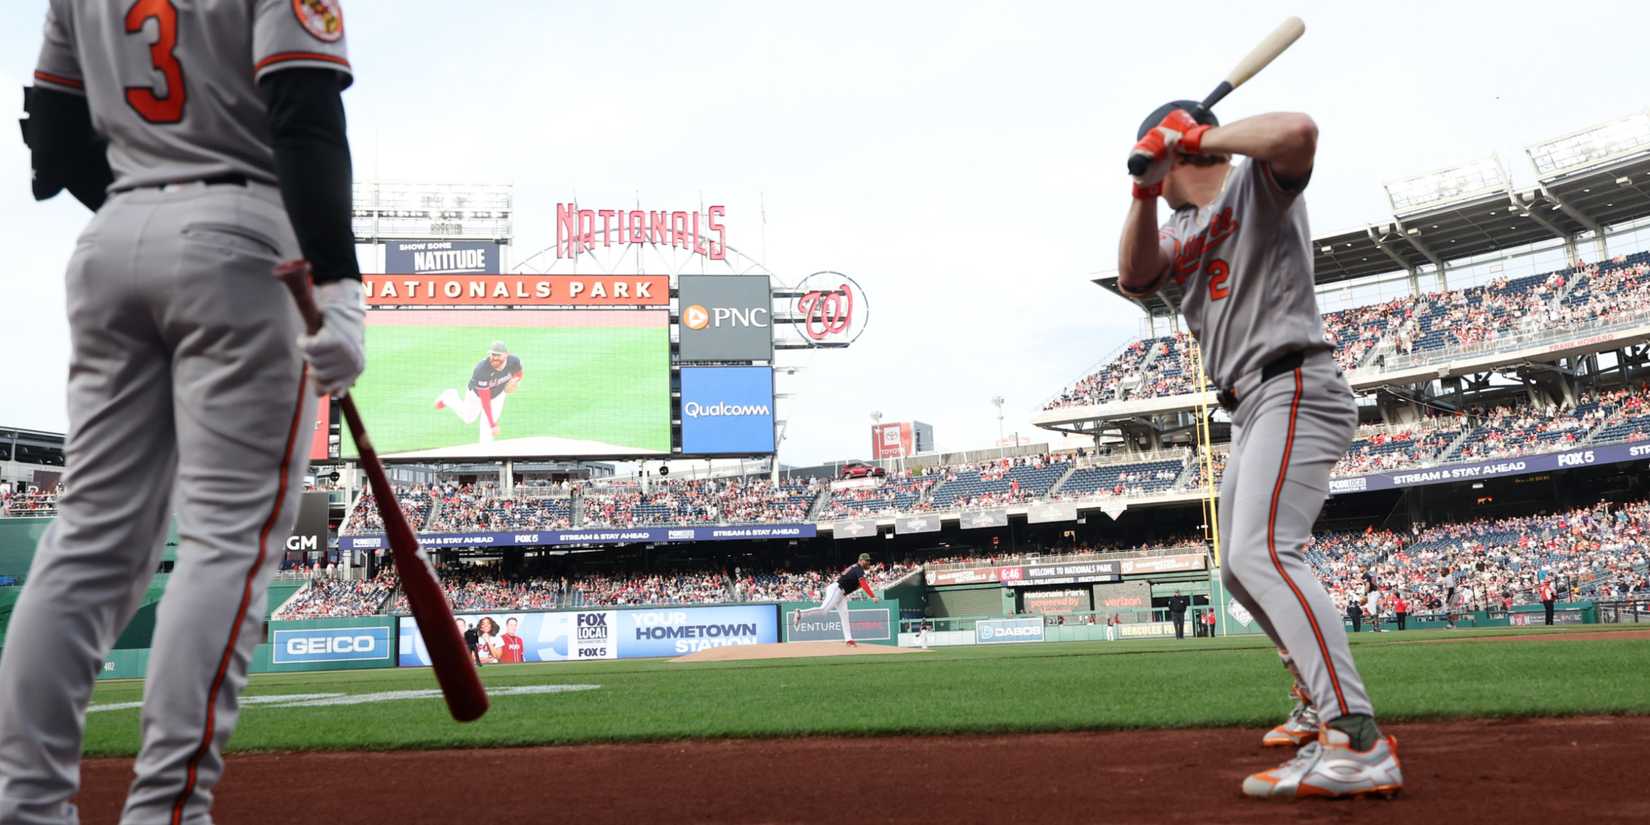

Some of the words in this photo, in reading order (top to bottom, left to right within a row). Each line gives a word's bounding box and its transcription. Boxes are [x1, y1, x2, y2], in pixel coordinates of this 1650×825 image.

[124, 0, 187, 125] 3
[556, 203, 725, 260] NATIONALS
[399, 243, 427, 251] SHOW
[414, 249, 486, 271] NATITUDE
[1206, 258, 1232, 302] 2
[362, 281, 552, 298] NATIONALS
[570, 281, 654, 298] PARK
[712, 307, 768, 328] PNC
[684, 401, 770, 418] Qualcomm
[1558, 453, 1585, 467] FOX
[1585, 452, 1595, 464] 5
[1393, 472, 1441, 485] STREAM
[1441, 471, 1450, 480] &
[1452, 467, 1481, 479] STAY
[1483, 461, 1526, 475] AHEAD
[464, 536, 494, 544] AHEAD
[620, 532, 649, 540] AHEAD
[1029, 567, 1056, 577] WELCOME
[1057, 566, 1064, 575] TO
[1064, 564, 1096, 575] NATIONALS
[1096, 563, 1112, 573] PARK
[577, 613, 607, 627] FOX
[632, 612, 688, 625] YOUR
[578, 627, 607, 639] LOCAL
[636, 623, 757, 640] HOMETOWN
[793, 621, 841, 632] VENTURE
[287, 635, 375, 655] GEICO
[578, 648, 598, 657] FOX
[599, 647, 607, 656] 5
[104, 661, 116, 672] 402
